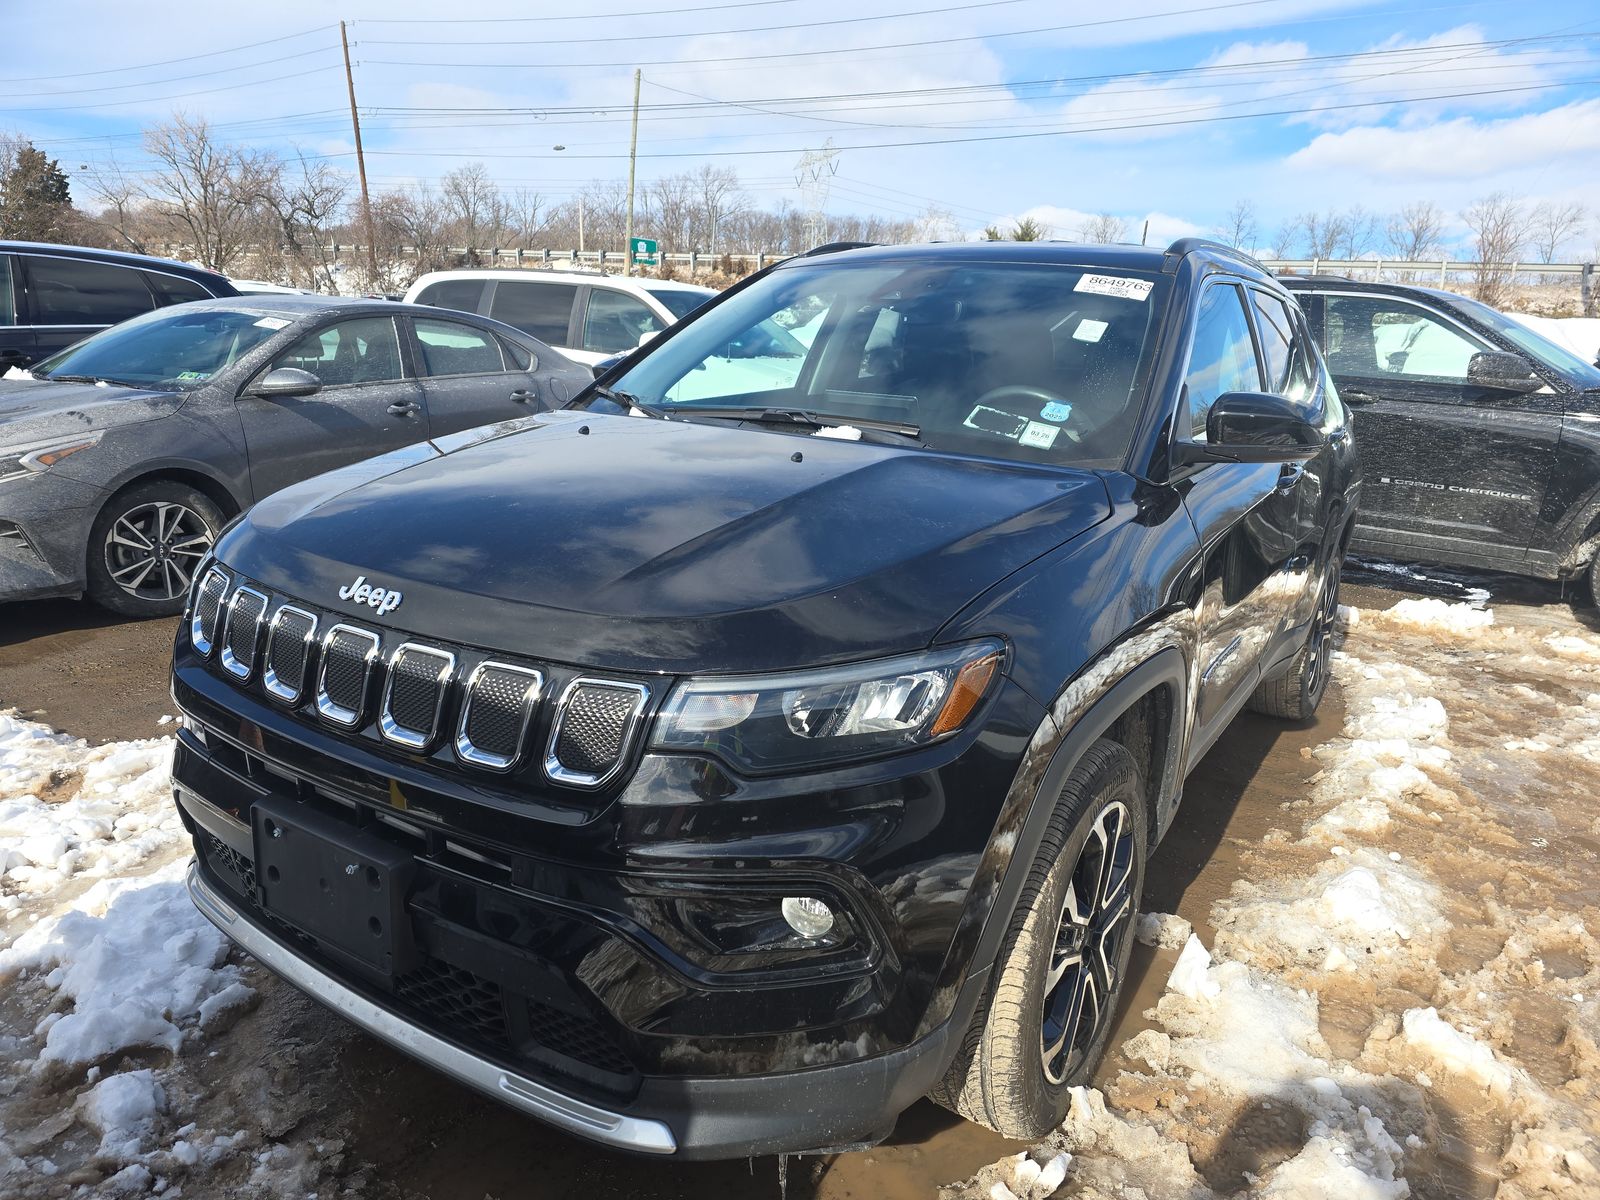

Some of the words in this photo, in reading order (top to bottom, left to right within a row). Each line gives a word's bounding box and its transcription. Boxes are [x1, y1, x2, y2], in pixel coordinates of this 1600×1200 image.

[1089, 276, 1152, 292] 8649763
[1394, 479, 1445, 490] GRAND
[1448, 485, 1532, 501] CHEROKEE
[338, 575, 403, 616] Jeep
